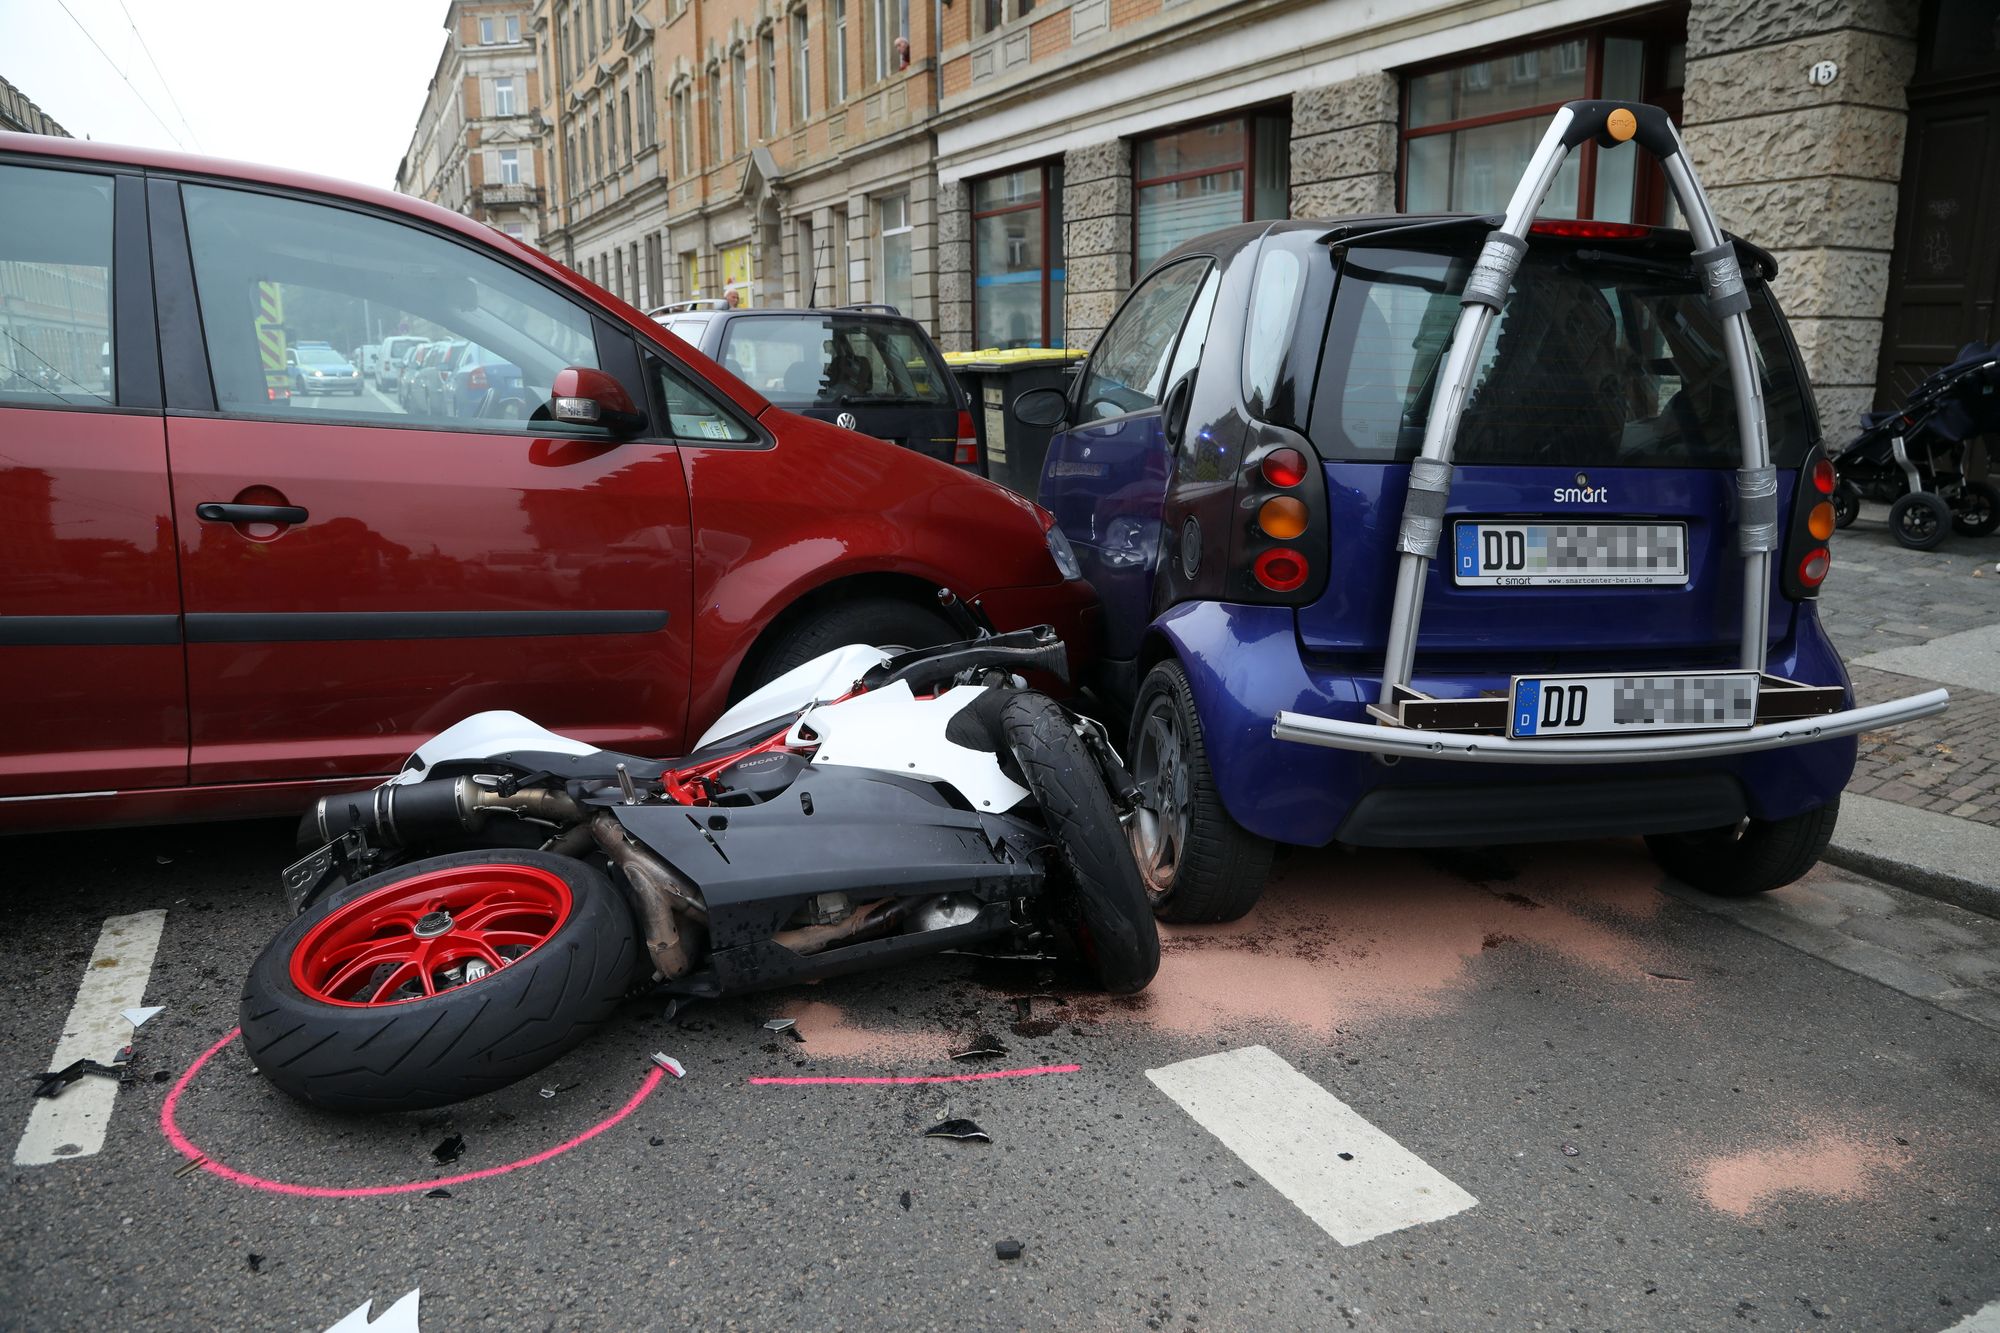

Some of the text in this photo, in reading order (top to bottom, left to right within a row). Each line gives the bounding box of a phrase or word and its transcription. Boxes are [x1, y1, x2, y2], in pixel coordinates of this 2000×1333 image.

[1813, 64, 1832, 81] 15
[1610, 118, 1635, 128] sma
[1553, 486, 1608, 503] smart
[1482, 530, 1526, 570] DD
[1463, 556, 1472, 568] D
[1505, 576, 1532, 585] smart
[1547, 576, 1654, 585] www.smartcenter-berlin.de
[1541, 685, 1588, 727] DD
[1521, 714, 1530, 726] D
[739, 755, 784, 769] DUCATI
